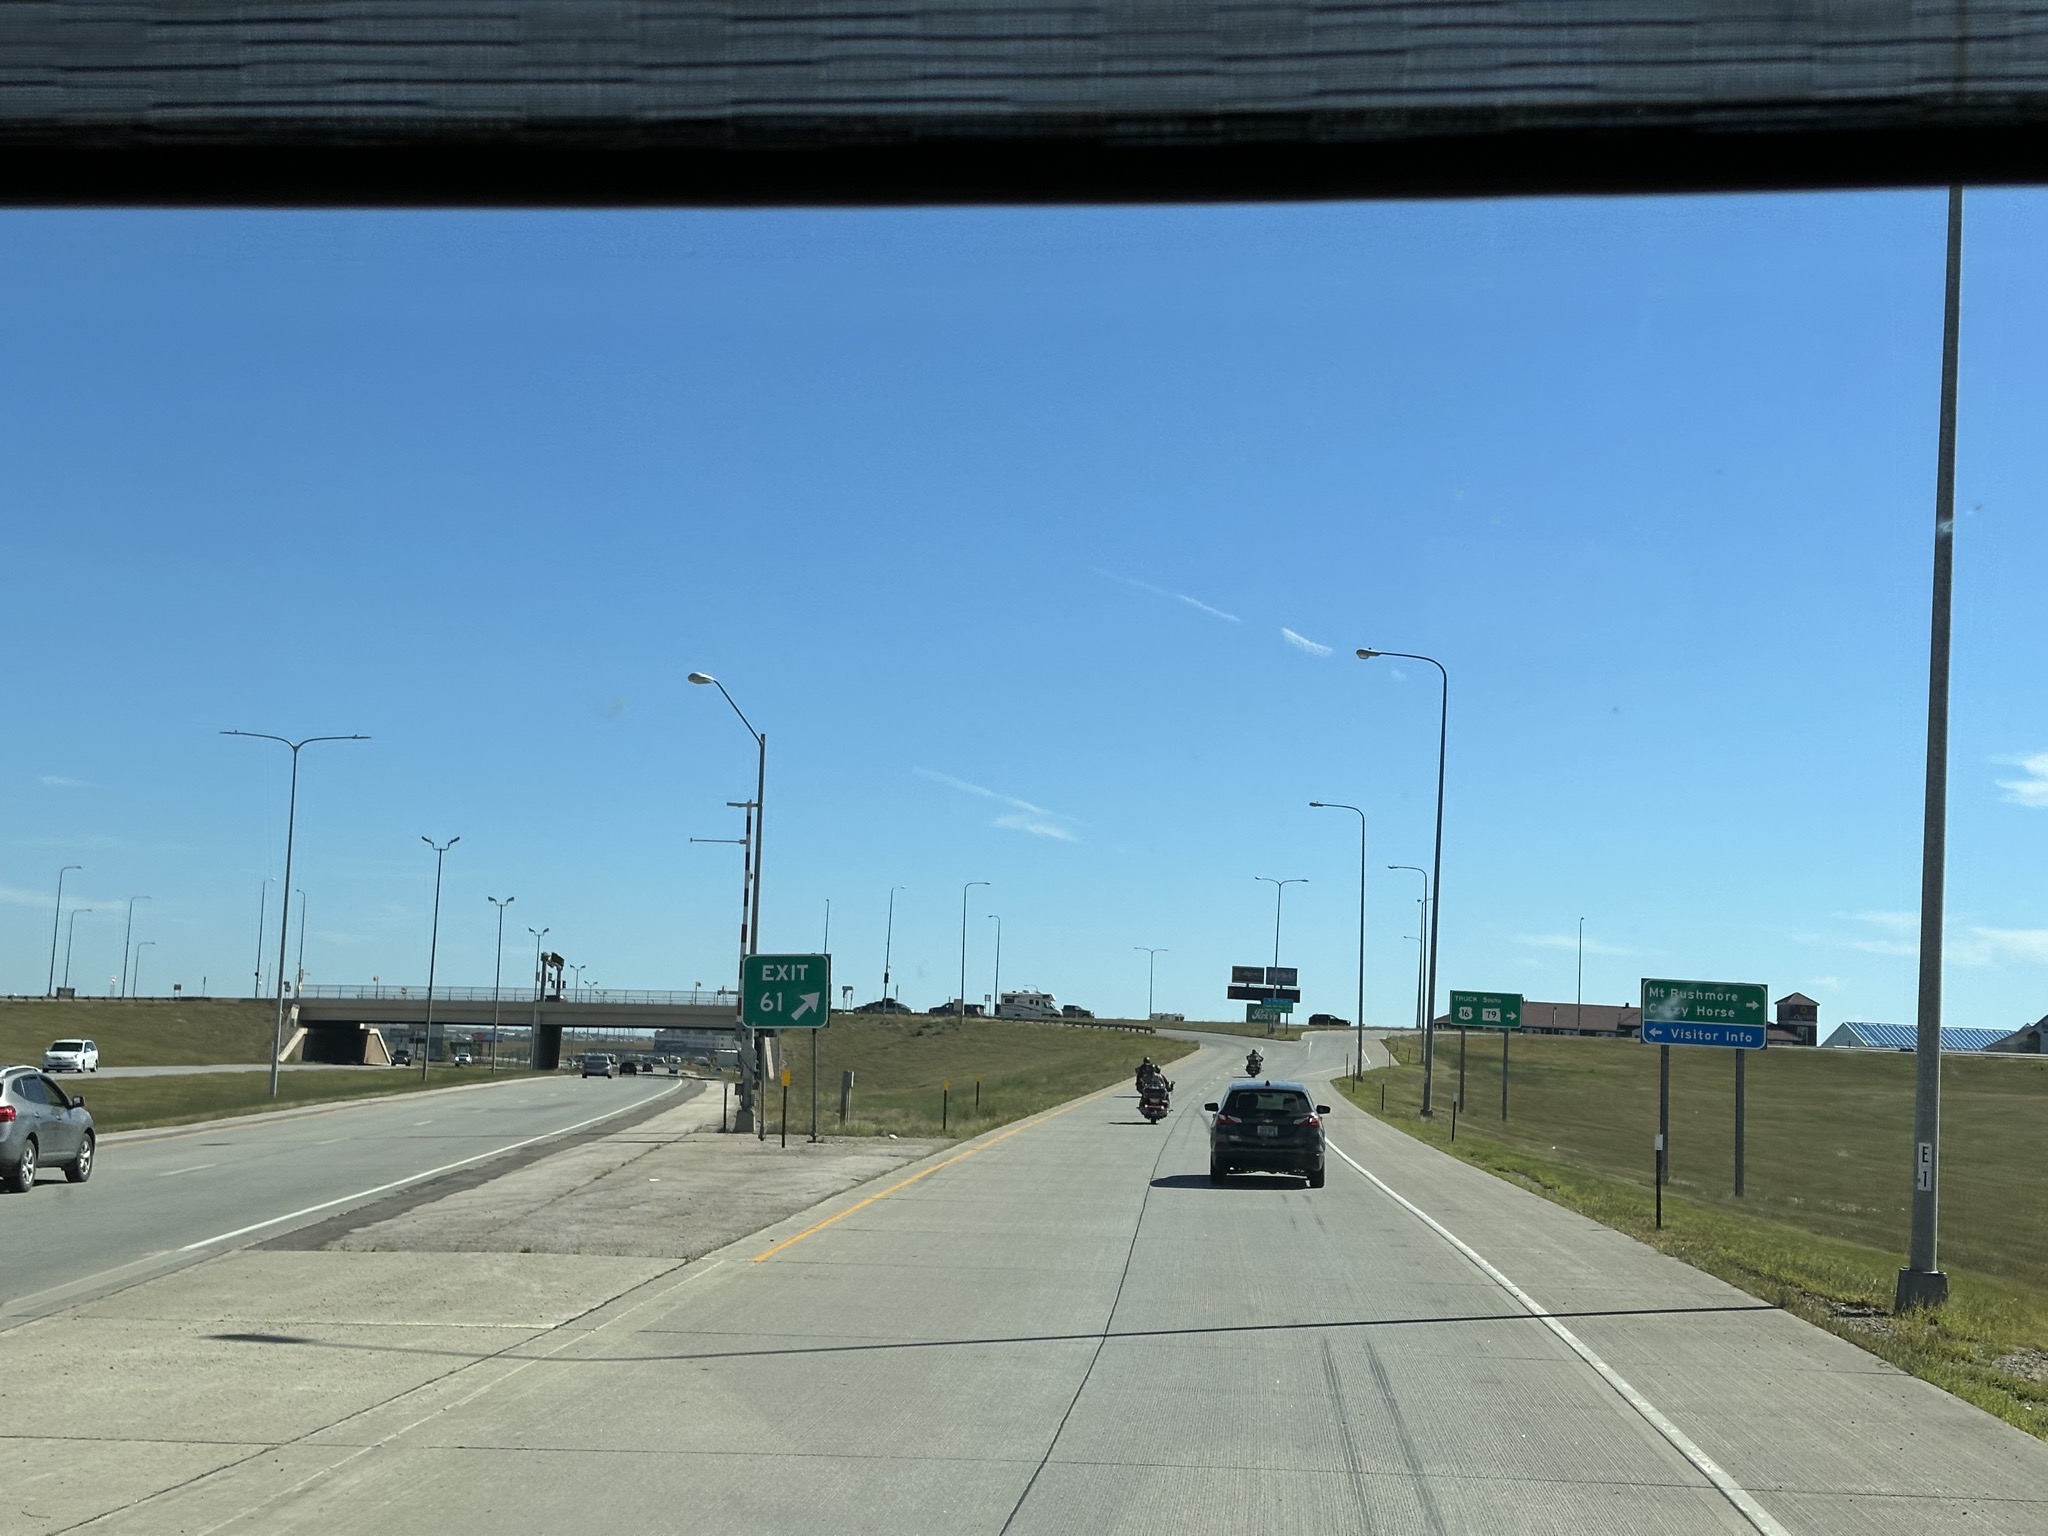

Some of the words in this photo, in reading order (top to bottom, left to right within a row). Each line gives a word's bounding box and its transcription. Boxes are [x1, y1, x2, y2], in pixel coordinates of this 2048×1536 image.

[762, 964, 809, 981] EXIT
[760, 992, 783, 1012] 61
[1455, 995, 1478, 1003] TRUCK
[1649, 987, 1665, 998] Mt
[1670, 988, 1739, 1002] Rushmore
[1461, 1009, 1470, 1018] 16
[1485, 1010, 1497, 1019] 79
[1697, 1006, 1736, 1018] Horse
[1671, 1028, 1719, 1041] Visitor
[1726, 1031, 1753, 1043] Info
[1922, 1146, 1930, 1163] E
